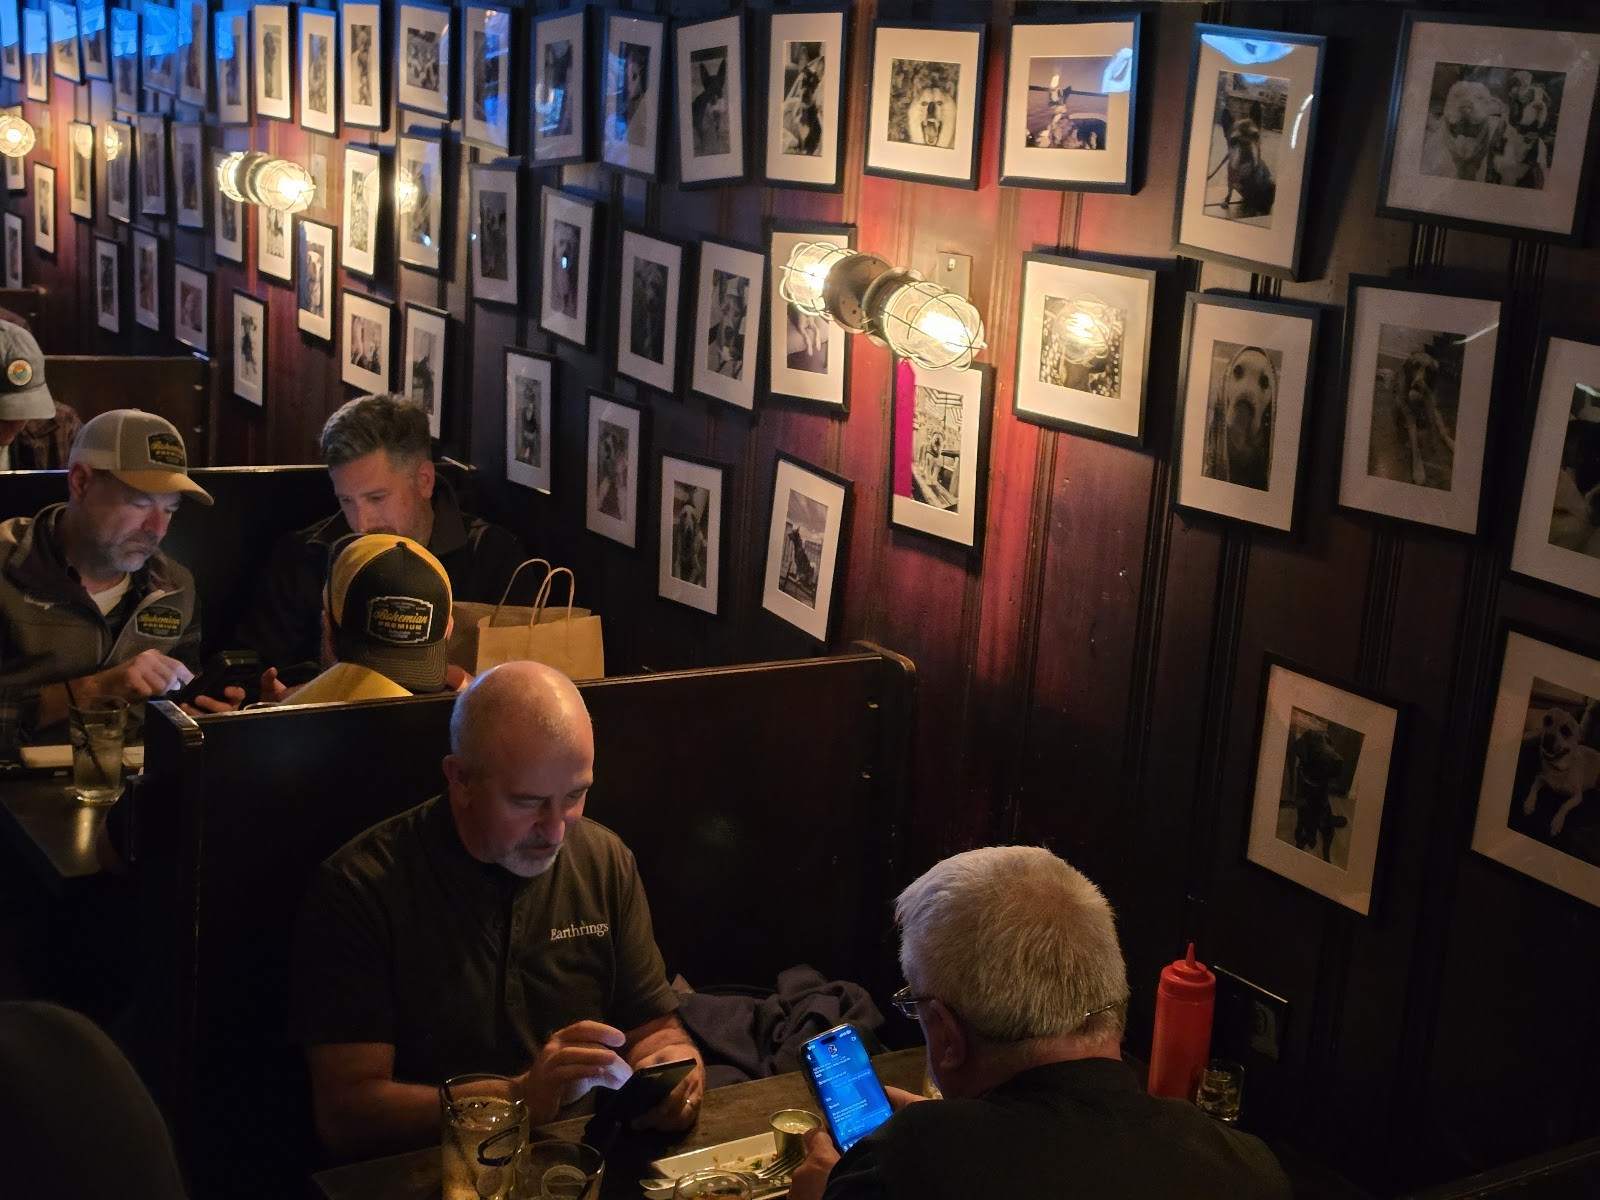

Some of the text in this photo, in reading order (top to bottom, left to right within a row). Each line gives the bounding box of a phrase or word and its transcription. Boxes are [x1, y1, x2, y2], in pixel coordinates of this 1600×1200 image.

[373, 608, 429, 624] Bohemian
[377, 620, 422, 631] PREMIUM
[550, 921, 609, 941] Earthrings
